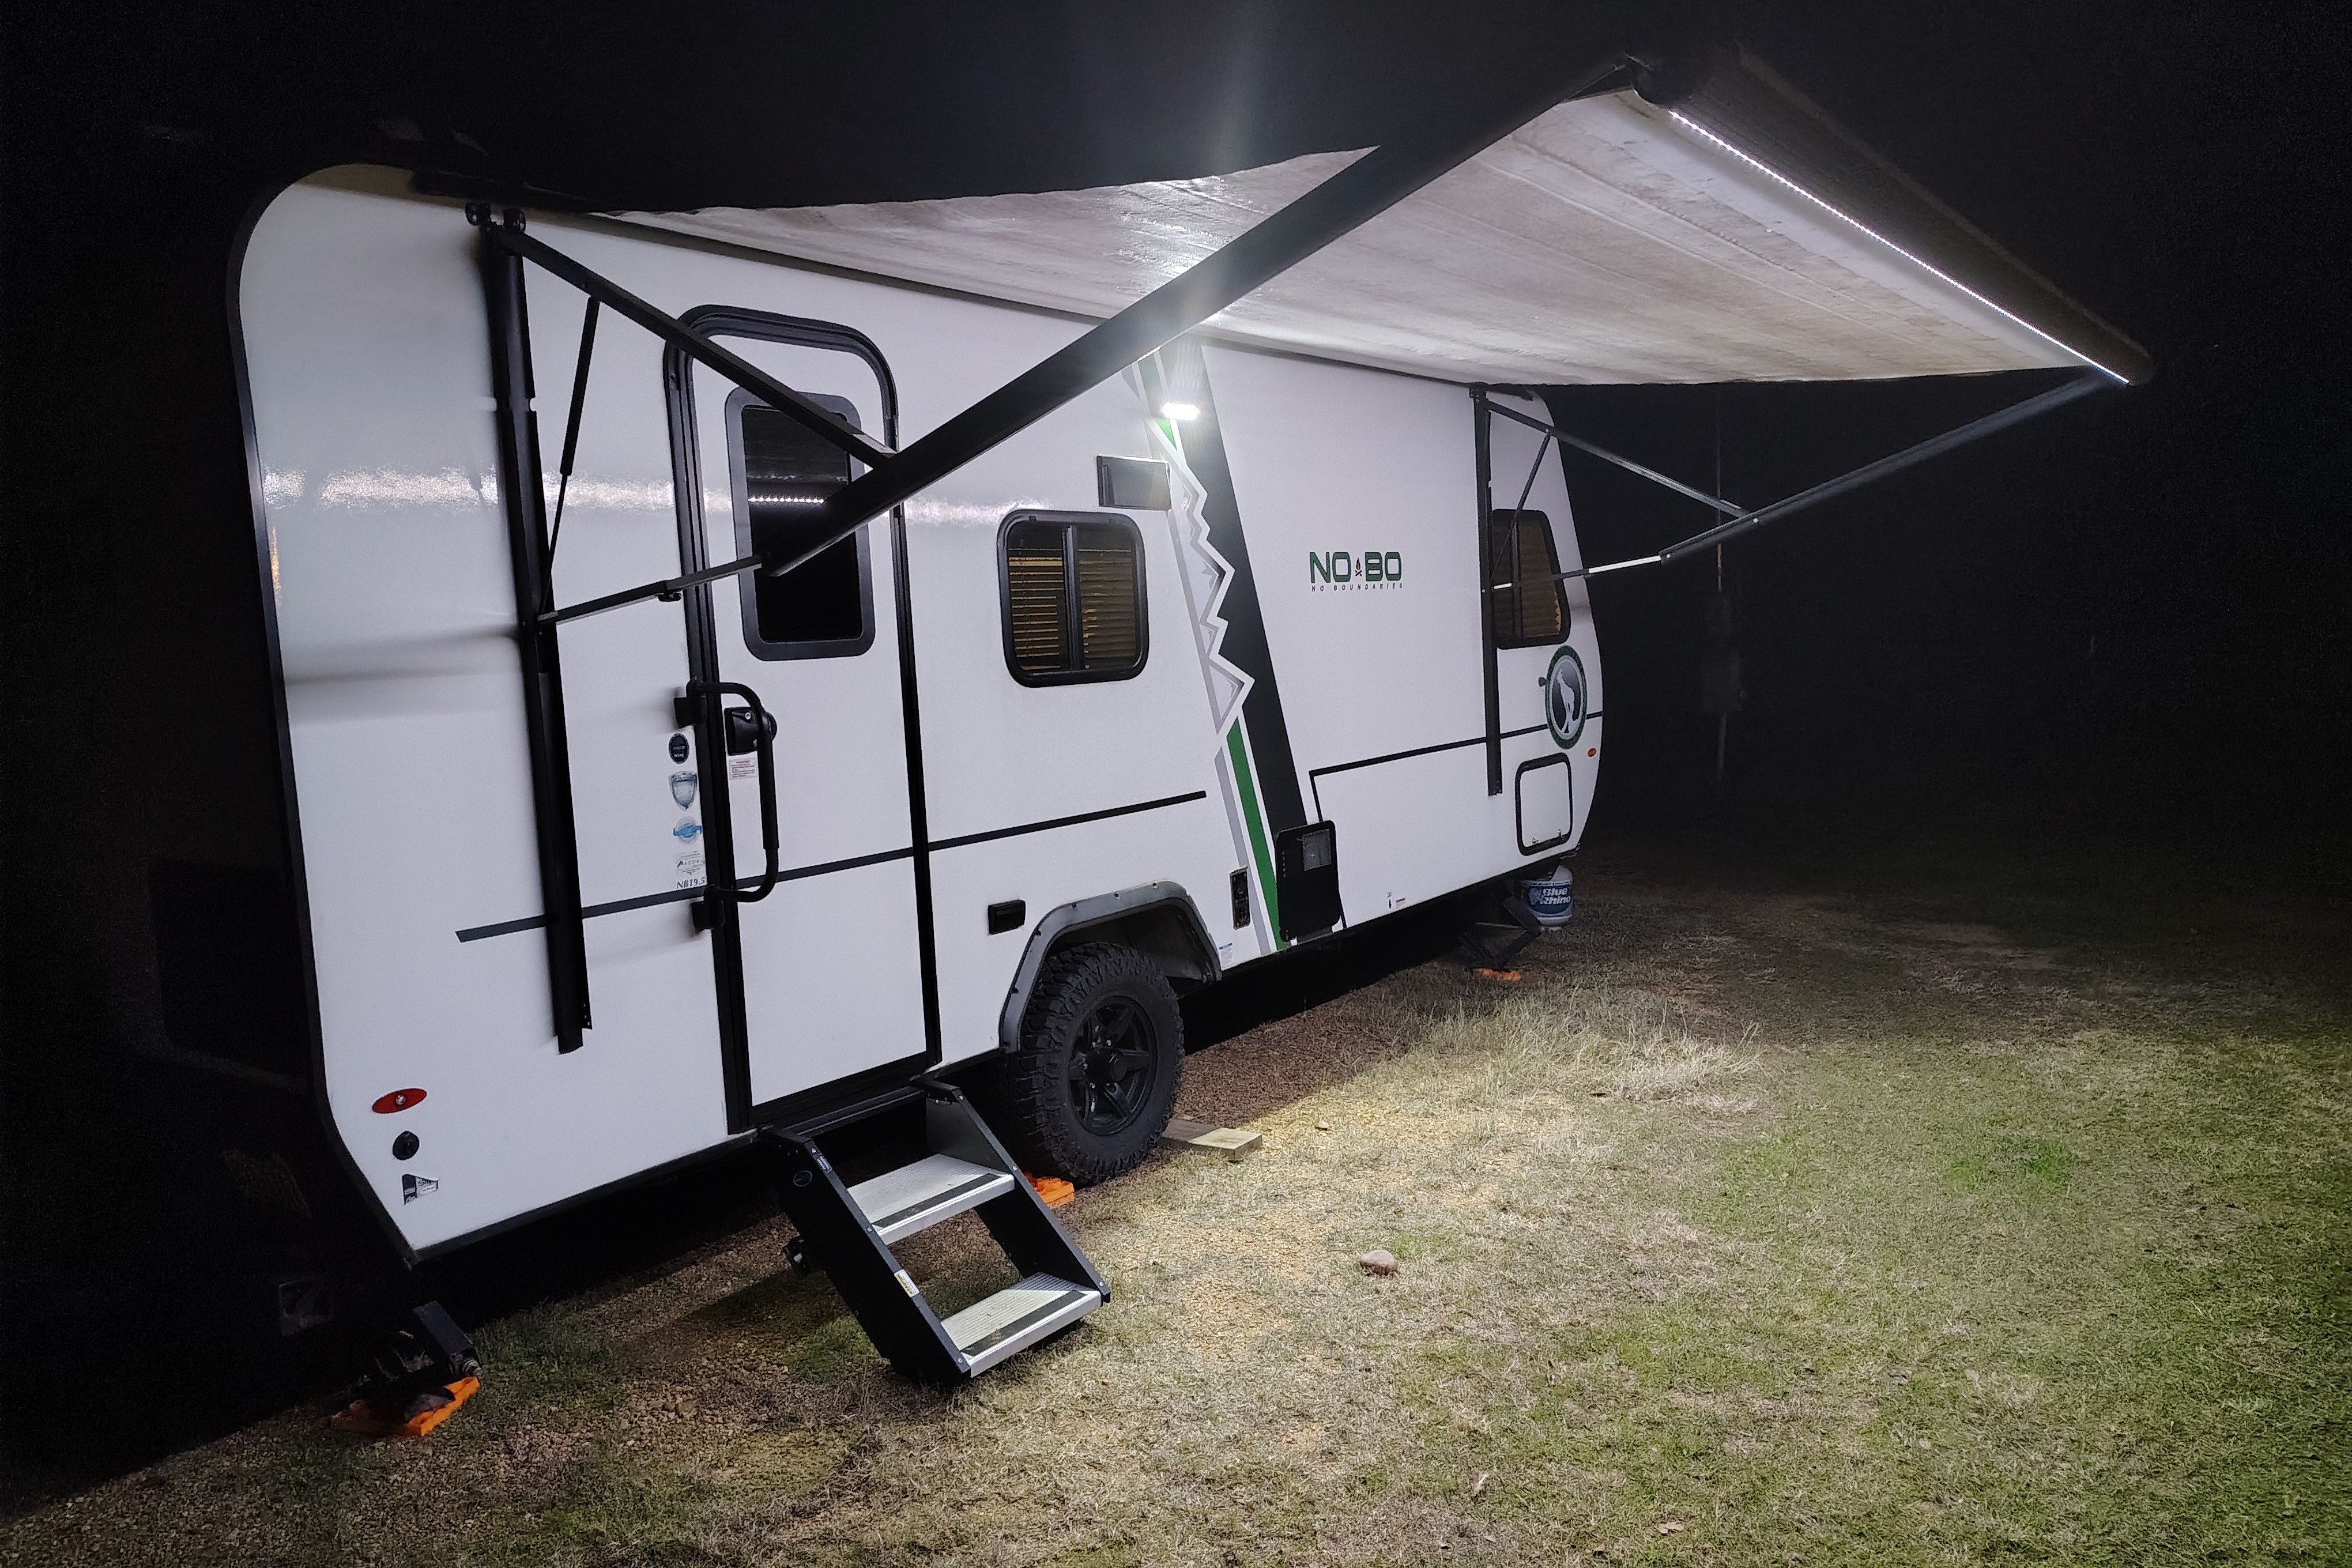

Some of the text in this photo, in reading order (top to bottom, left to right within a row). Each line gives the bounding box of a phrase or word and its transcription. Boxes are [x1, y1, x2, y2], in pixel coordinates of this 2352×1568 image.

[1309, 552, 1402, 583] NO BO
[1333, 582, 1403, 591] BOUNDARIES
[676, 876, 706, 889] NB19.5
